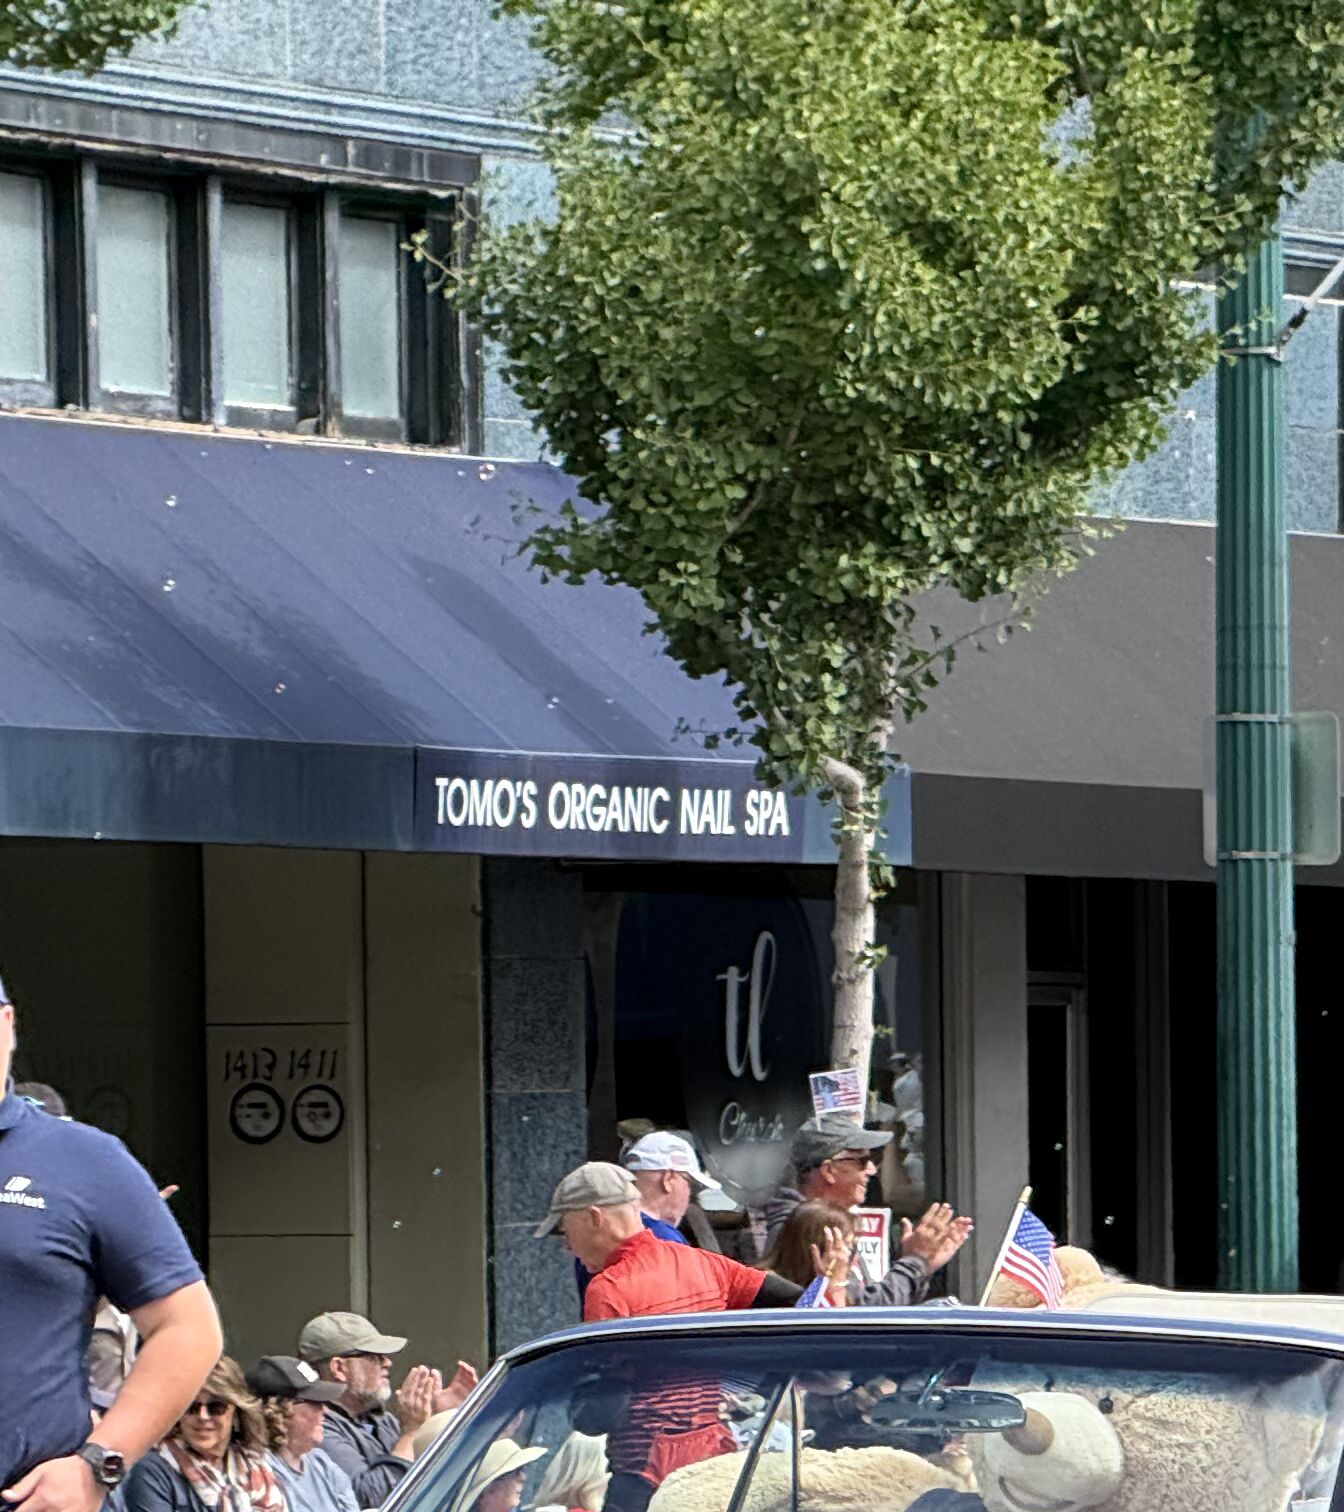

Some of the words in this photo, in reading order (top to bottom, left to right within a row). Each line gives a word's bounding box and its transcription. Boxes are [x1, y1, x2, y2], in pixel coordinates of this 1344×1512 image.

[435, 777, 538, 829] TOMO'S
[547, 781, 671, 833] ORGANIC
[680, 787, 736, 836] NAIL
[743, 789, 791, 837] SPA
[223, 1047, 277, 1081] 1413
[288, 1048, 338, 1081] 1411
